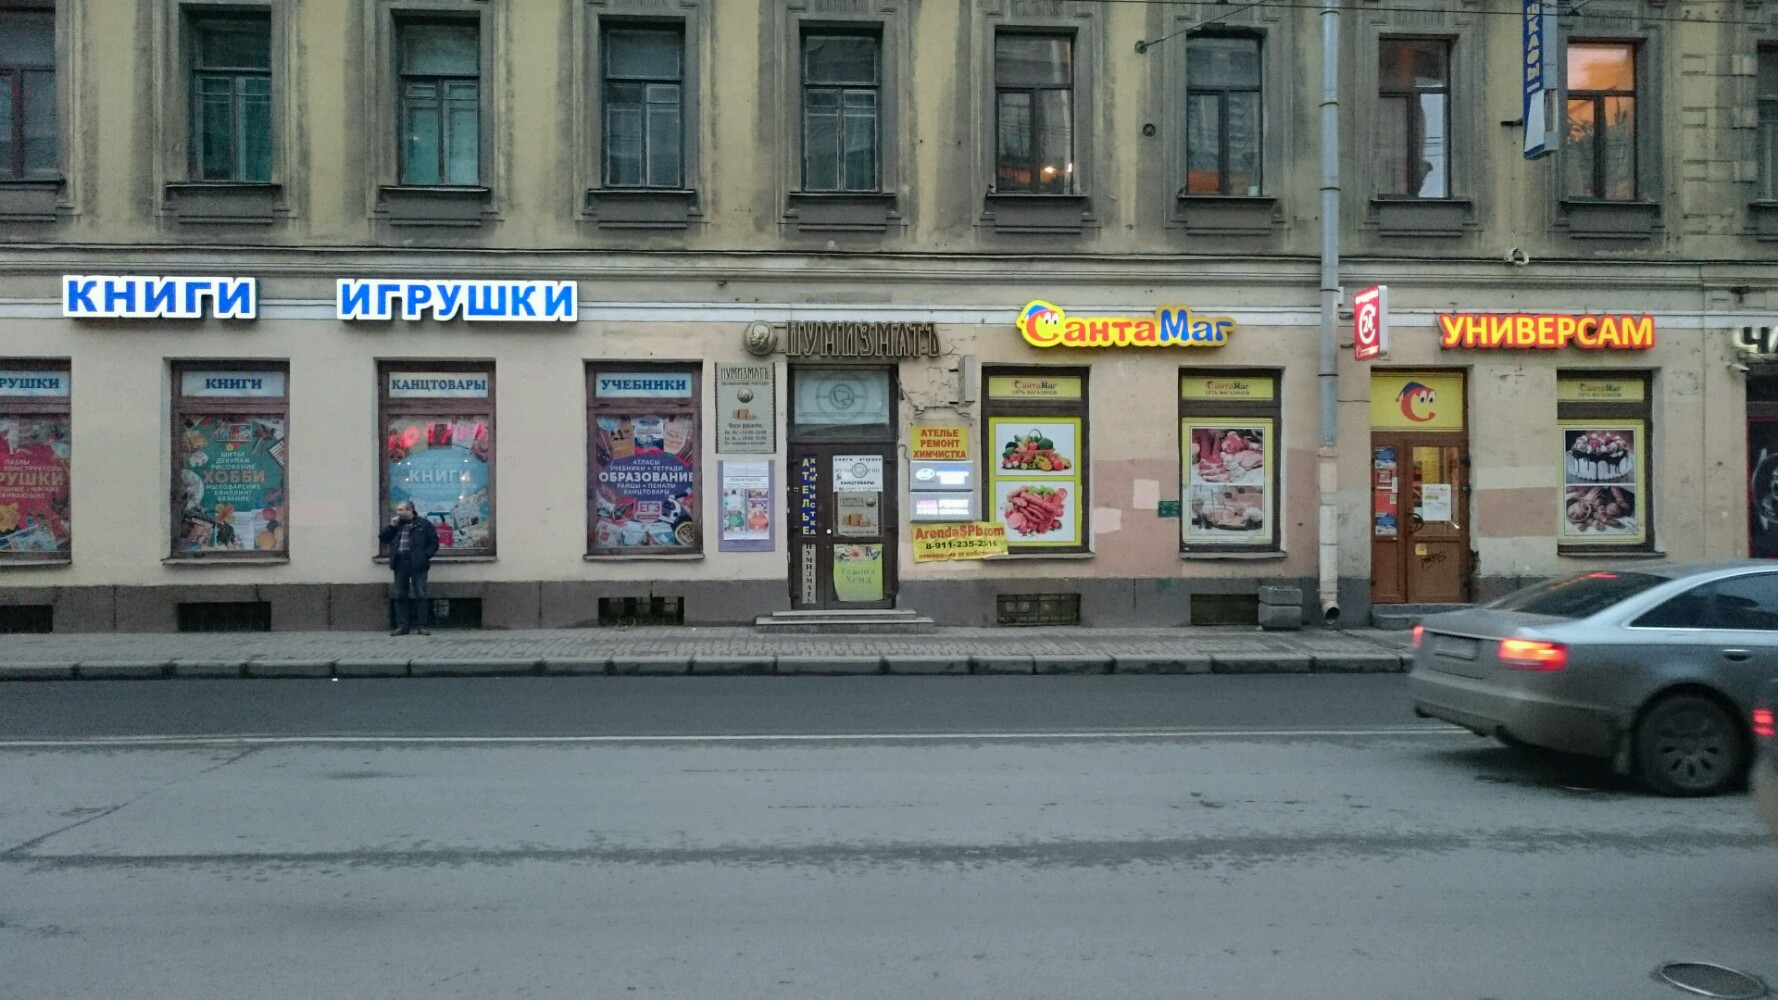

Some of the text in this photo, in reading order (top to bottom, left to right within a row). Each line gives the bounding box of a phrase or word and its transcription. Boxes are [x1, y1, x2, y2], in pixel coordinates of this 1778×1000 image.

[67, 279, 252, 315] КНИГИ
[341, 282, 574, 318] ИГРУШКИ
[1442, 316, 1653, 346] УНИВЕРСАМ
[786, 321, 941, 356] НУМИЗМАТЪ
[205, 378, 262, 390] КНИГИ
[391, 379, 486, 392] КАНЦТОВАРЫ
[601, 379, 686, 391] УЧЕБНИКИ
[920, 429, 960, 438] АТЕЛЬЕ
[920, 440, 961, 448] РЕМОНТ
[913, 450, 967, 459] ХИМЧИСТКА
[204, 471, 265, 483] ХОББИ
[409, 469, 471, 482] КНИГИ
[599, 472, 693, 482] ОБРАЗОВАНИЕ
[802, 458, 810, 535] АТЕЛЬЕ
[809, 458, 817, 535] ХИМЧИСТКА
